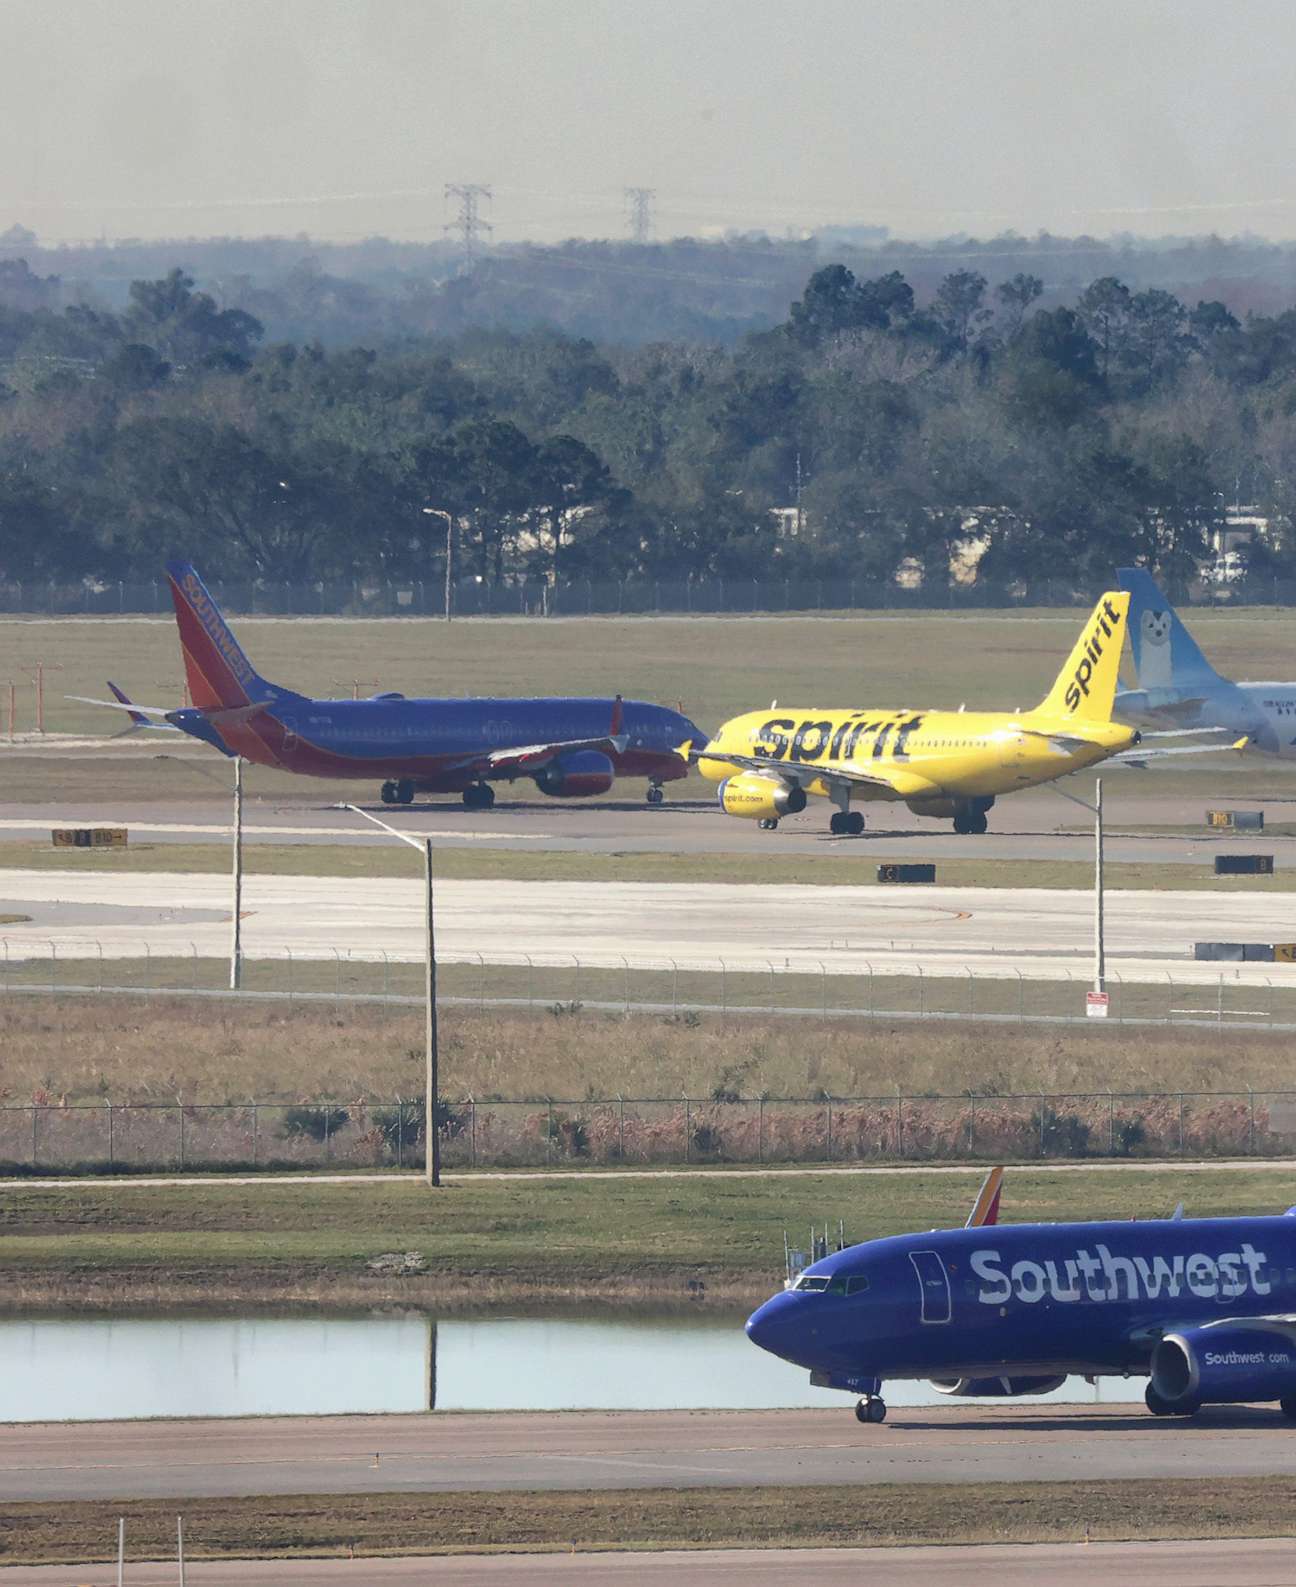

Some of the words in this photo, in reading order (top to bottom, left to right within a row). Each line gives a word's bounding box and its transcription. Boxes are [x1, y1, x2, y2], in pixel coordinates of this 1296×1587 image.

[182, 574, 254, 684] SOUTHWEST
[1065, 599, 1120, 713] spirit
[753, 712, 926, 763] spirit
[970, 1244, 1271, 1305] Southwest
